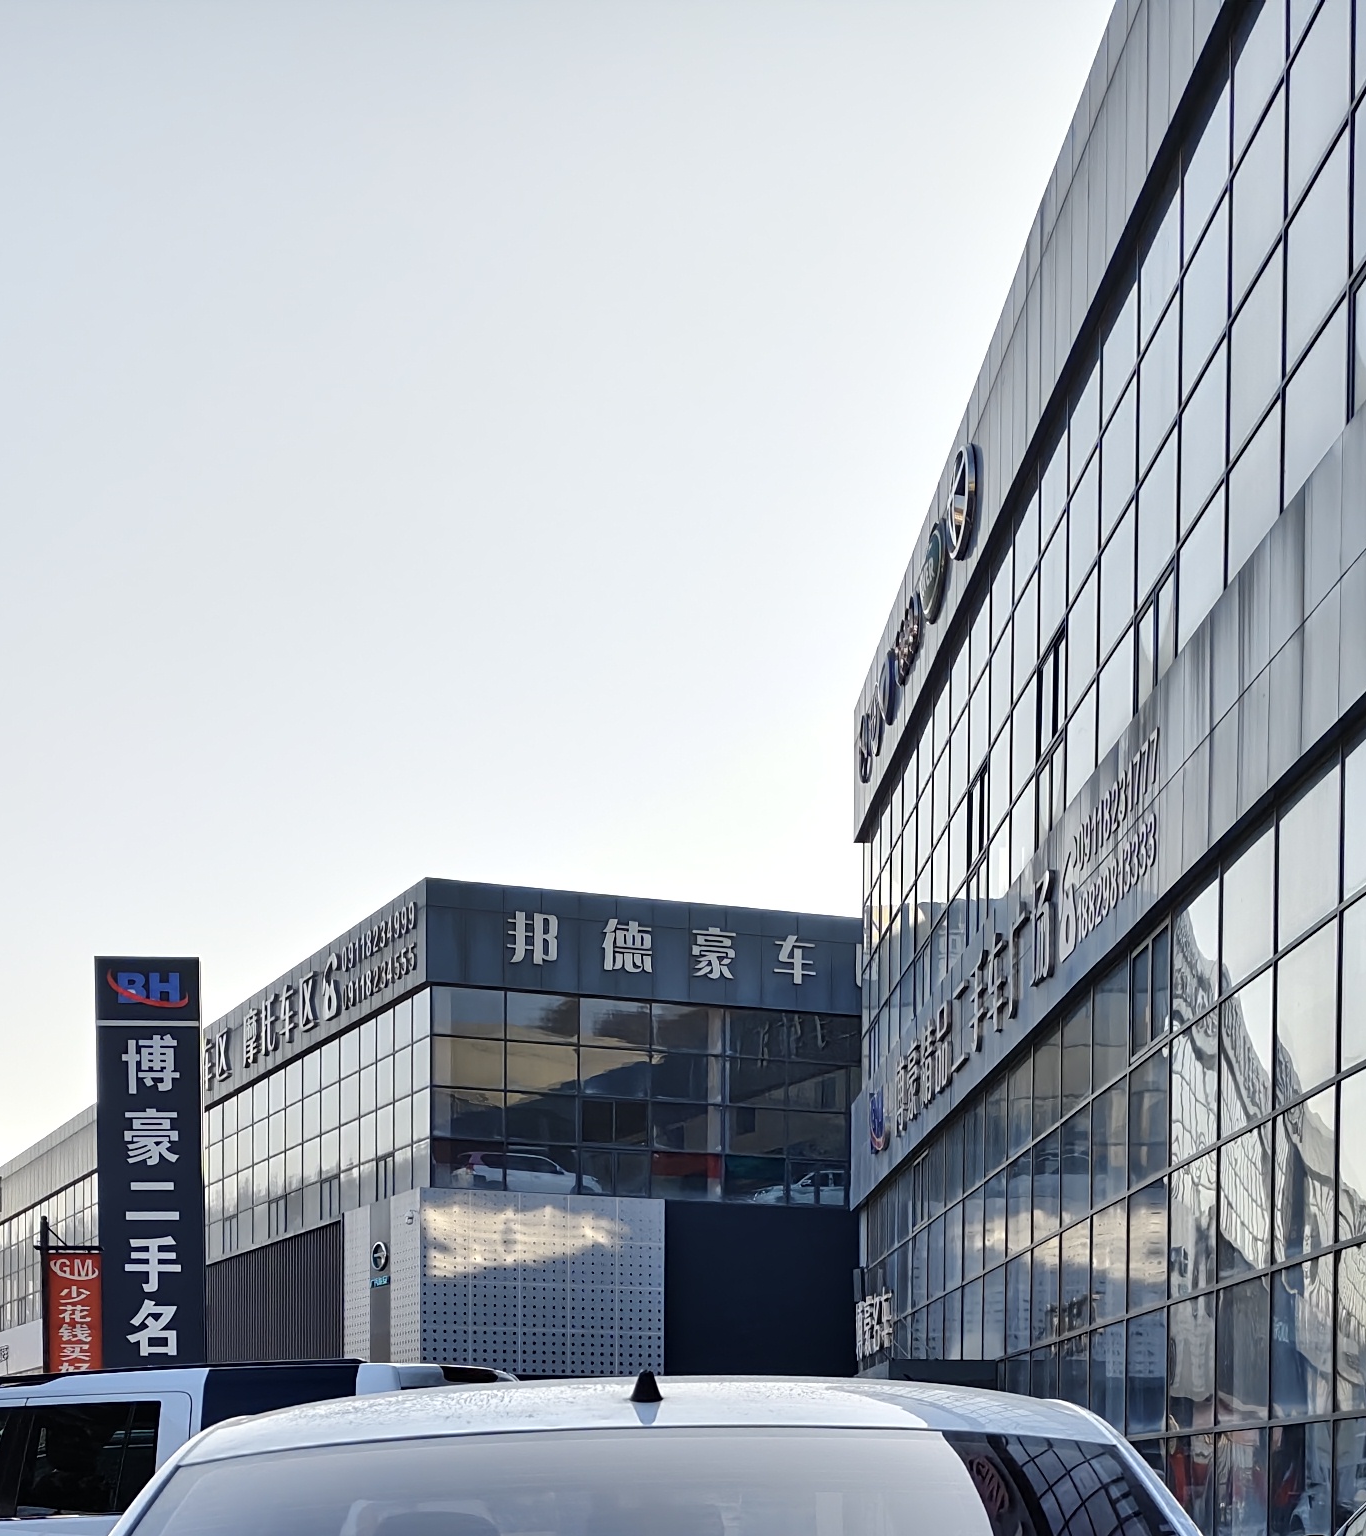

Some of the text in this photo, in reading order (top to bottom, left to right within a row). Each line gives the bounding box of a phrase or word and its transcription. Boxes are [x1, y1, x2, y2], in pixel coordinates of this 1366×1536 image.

[341, 901, 418, 972] 09118234999
[507, 910, 863, 988] 邦德豪车
[114, 969, 184, 1006] BH
[341, 943, 418, 1010] 09118234555
[243, 971, 319, 1068] 摩托车区
[52, 1258, 98, 1280] GM
